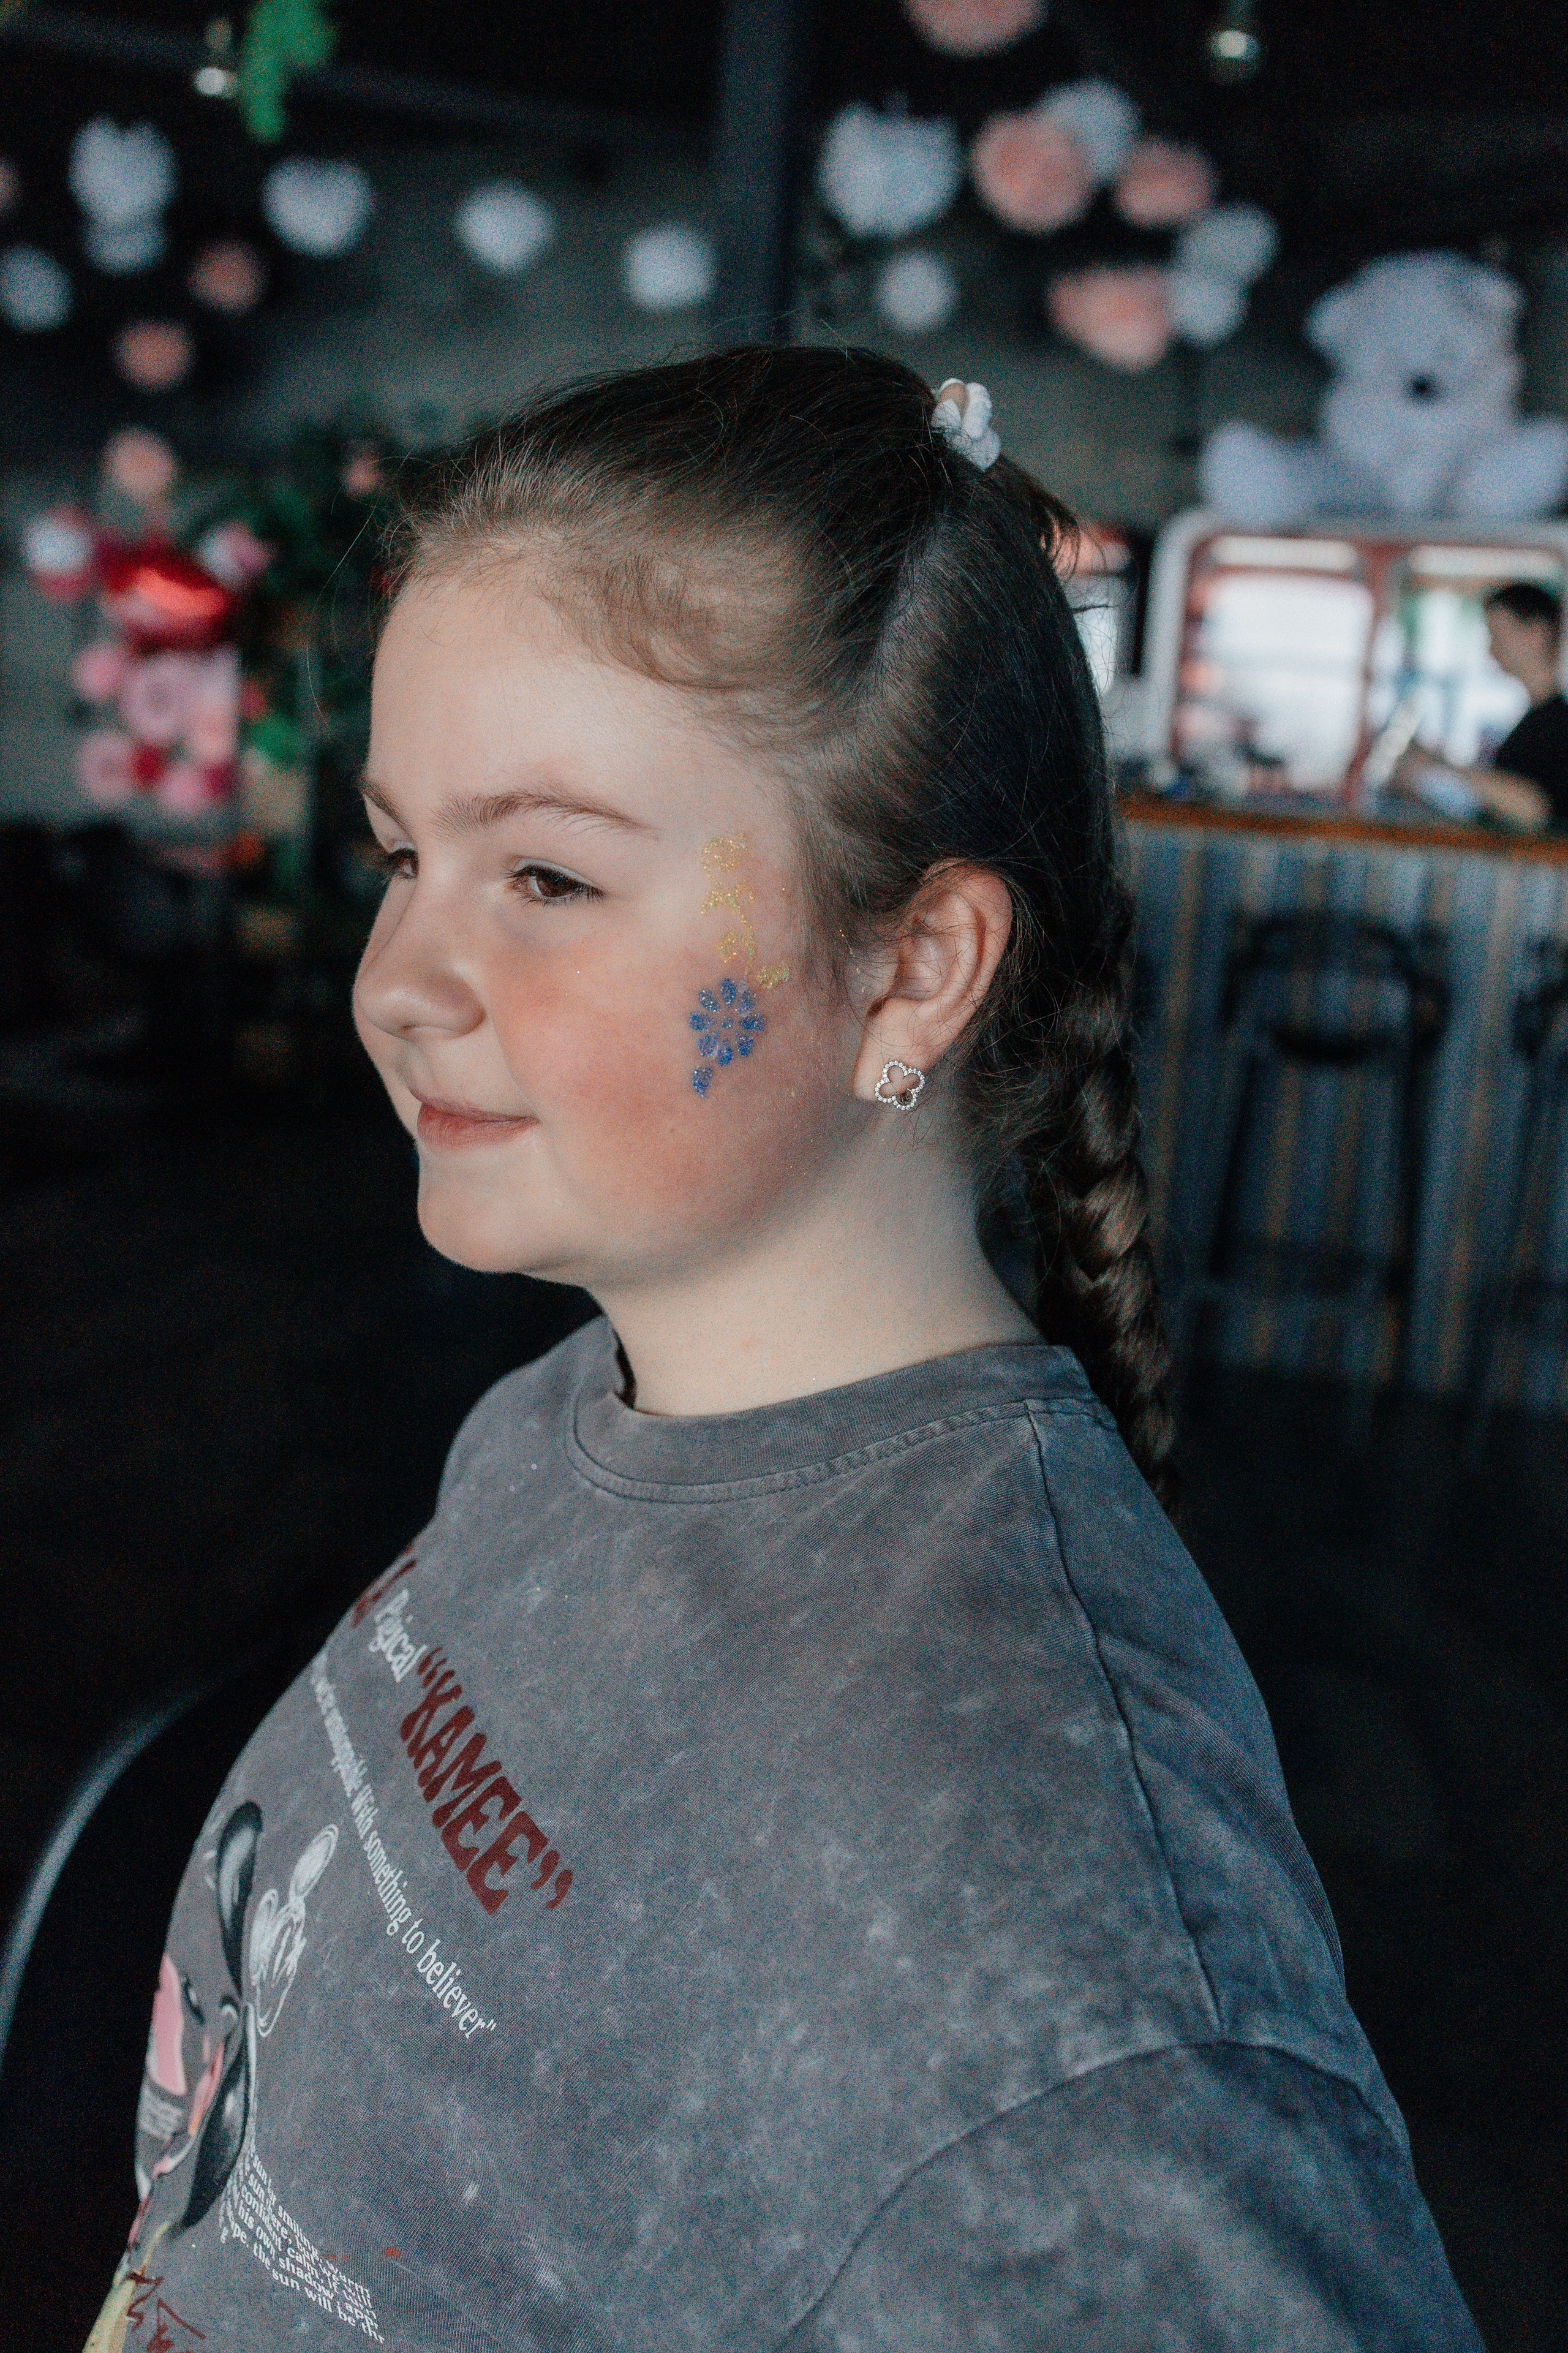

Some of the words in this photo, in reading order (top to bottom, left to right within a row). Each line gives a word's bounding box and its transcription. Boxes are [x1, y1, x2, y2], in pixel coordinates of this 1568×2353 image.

[351, 1783, 379, 1841] With
[364, 1828, 412, 1936] something
[402, 1918, 426, 1954] to
[248, 2173, 265, 2203] sun
[252, 2154, 267, 2185] sun
[238, 2199, 255, 2229] his
[255, 2226, 275, 2260] own
[253, 2242, 271, 2270] the
[272, 2268, 300, 2291] sun
[304, 2286, 333, 2313] will
[337, 2305, 356, 2327] be
